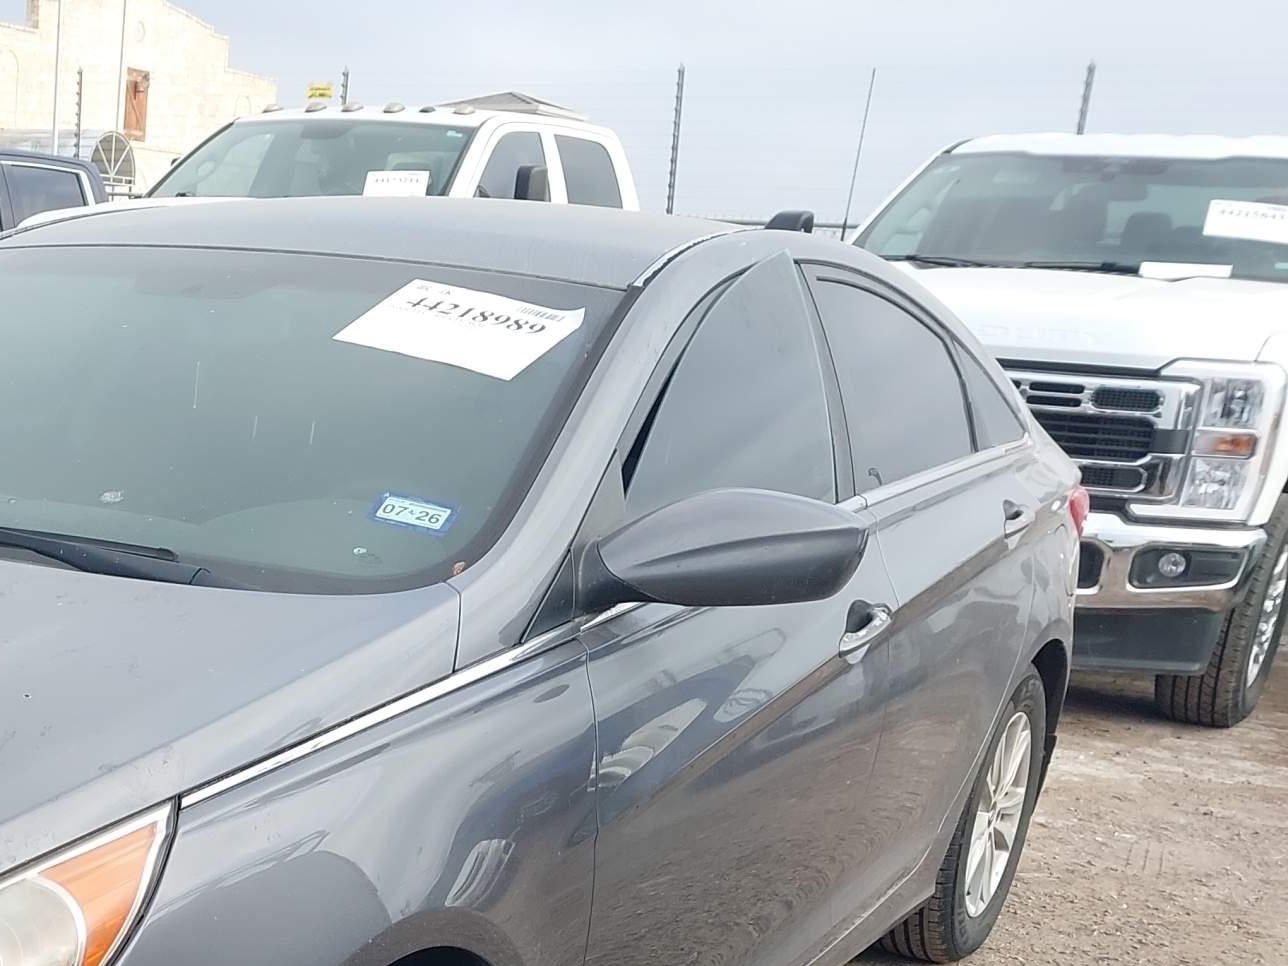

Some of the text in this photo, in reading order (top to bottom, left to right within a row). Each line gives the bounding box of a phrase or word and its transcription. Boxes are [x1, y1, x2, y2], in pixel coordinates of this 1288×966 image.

[407, 297, 547, 334] 44218989
[382, 503, 409, 517] 07
[415, 510, 442, 524] 26
